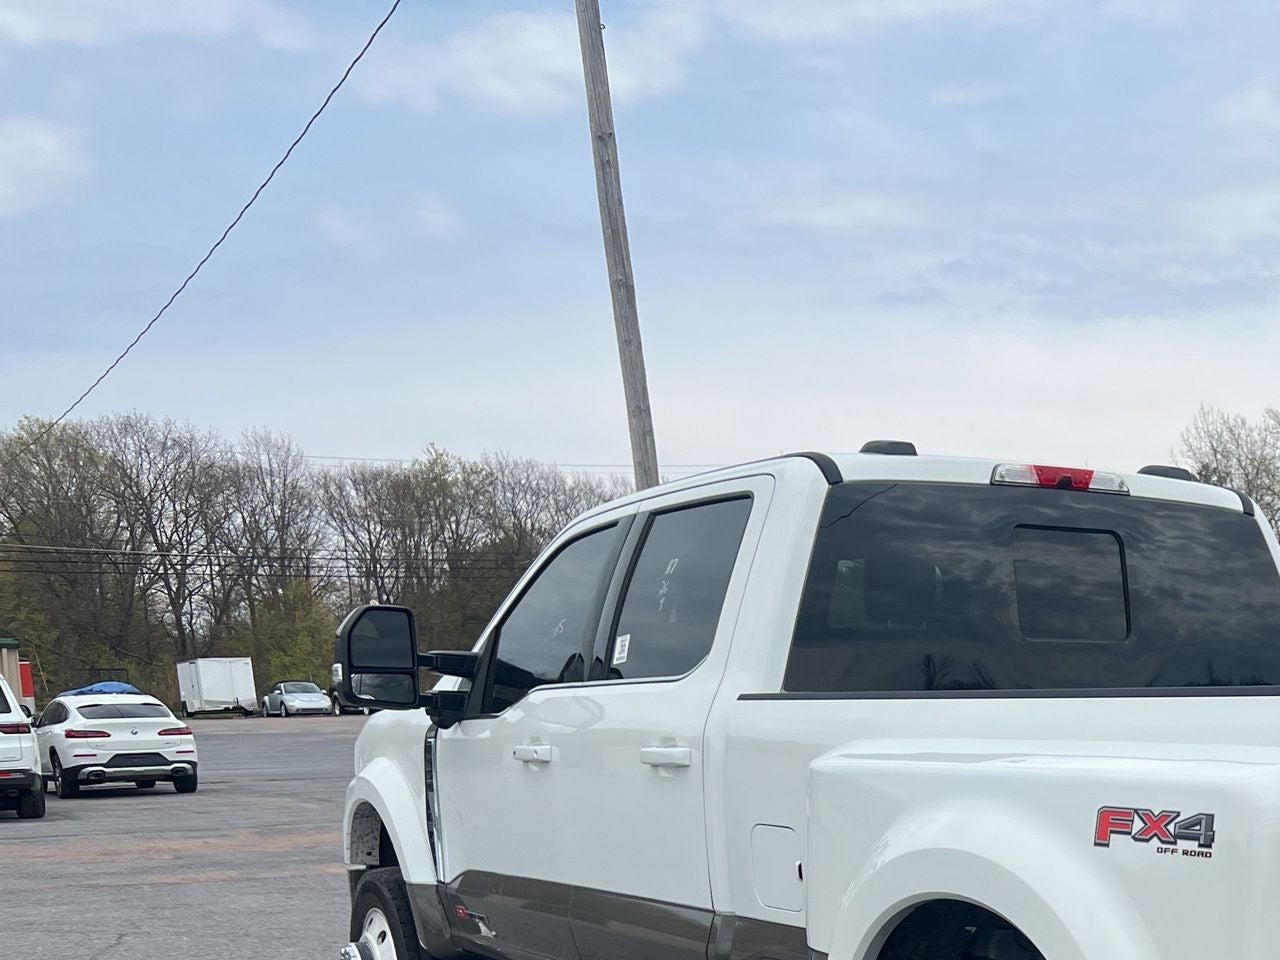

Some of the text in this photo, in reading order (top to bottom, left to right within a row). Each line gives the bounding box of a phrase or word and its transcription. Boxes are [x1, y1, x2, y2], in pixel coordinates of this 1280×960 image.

[1093, 805, 1216, 849] FX4
[1156, 846, 1213, 859] OFF ROAD
